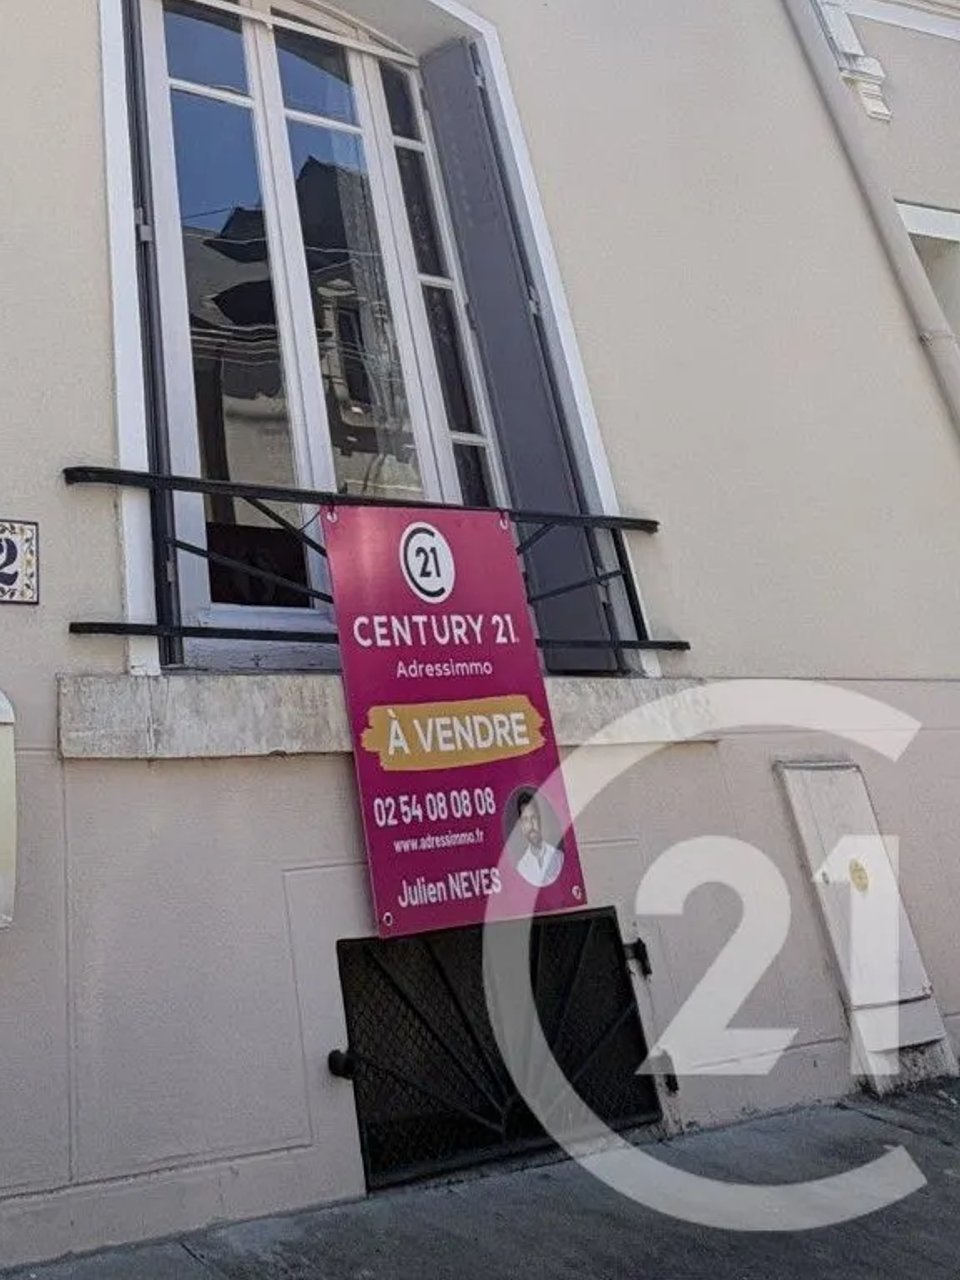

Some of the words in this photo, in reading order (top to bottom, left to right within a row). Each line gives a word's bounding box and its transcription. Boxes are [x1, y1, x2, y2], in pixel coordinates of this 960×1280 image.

[415, 546, 441, 578] 21
[353, 614, 483, 647] CENTURY
[492, 614, 516, 643] 21
[396, 658, 493, 678] Adressimmo
[387, 708, 410, 755] À
[413, 712, 530, 753] VENDRE
[373, 796, 398, 827] 02
[399, 794, 423, 824] 54
[425, 792, 448, 821] 08
[450, 789, 472, 819] 08
[474, 787, 496, 816] 08
[393, 828, 484, 853] www.adressimmo.fr
[398, 877, 447, 907] Julien
[448, 867, 502, 900] NEVES
